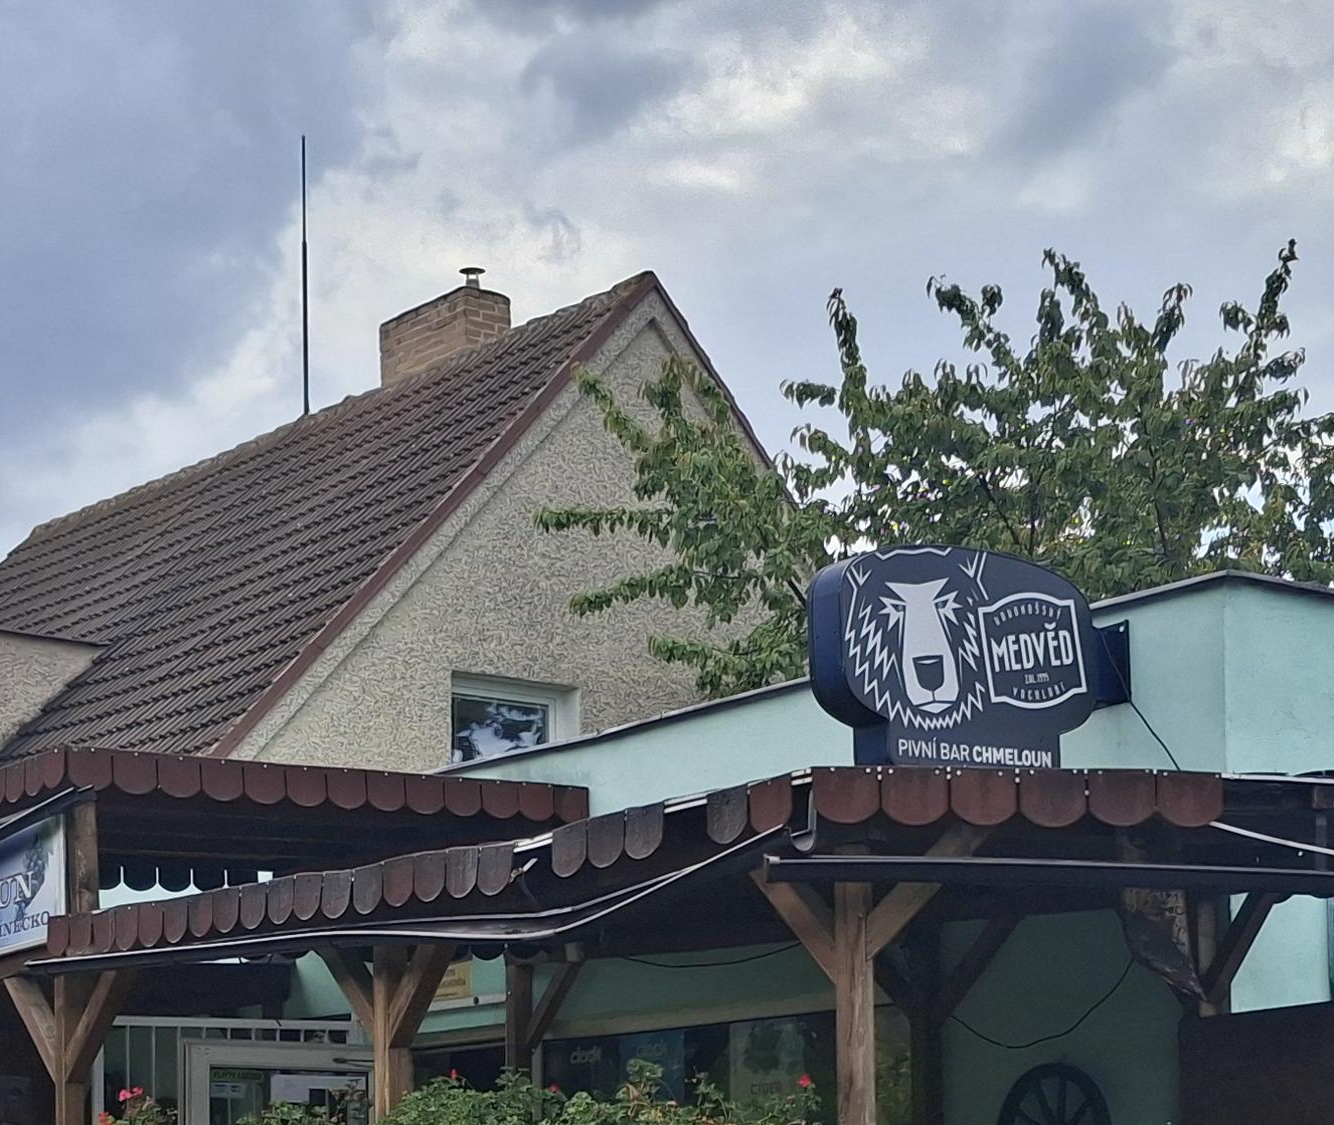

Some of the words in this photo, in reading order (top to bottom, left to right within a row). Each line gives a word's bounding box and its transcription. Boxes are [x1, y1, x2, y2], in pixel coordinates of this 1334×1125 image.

[990, 621, 1074, 673] MEDVĚD
[898, 737, 937, 759] PIVNÍ
[940, 743, 970, 762] BAR
[972, 746, 1052, 768] CHMELOUN
